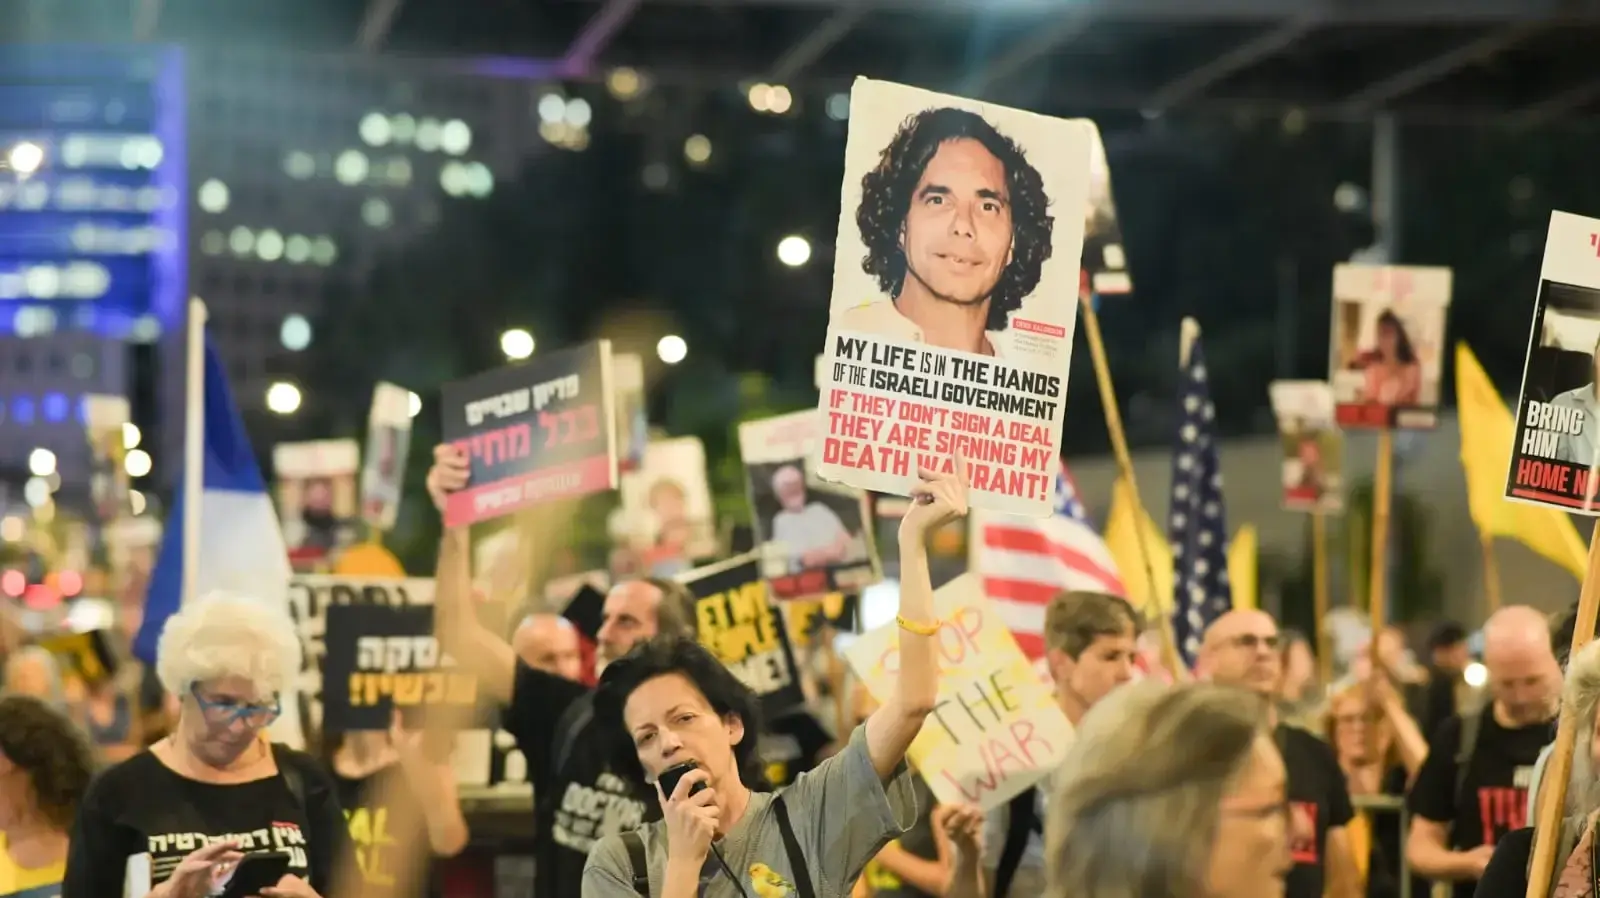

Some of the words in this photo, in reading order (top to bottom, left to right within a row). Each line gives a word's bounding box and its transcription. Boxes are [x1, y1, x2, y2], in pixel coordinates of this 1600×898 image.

[833, 362, 847, 382] OF
[848, 365, 868, 388] THE
[869, 369, 939, 400] ISRAELI
[942, 382, 1058, 421] GOVERNMENT
[835, 336, 868, 361] MY
[871, 343, 917, 371] LIFE
[920, 351, 933, 374] IS
[934, 354, 947, 377] IN
[951, 357, 989, 384] THE
[993, 365, 1061, 398] HANDS
[537, 404, 599, 451] בכל
[829, 389, 848, 409] IF
[850, 393, 897, 418] THEY
[898, 402, 949, 428] DON'T
[951, 411, 991, 436] SIGN
[992, 419, 1005, 439] A
[1009, 422, 1053, 447] DEAL
[829, 412, 884, 441] THEY
[887, 423, 932, 450] ARE
[936, 431, 1018, 466] SIGNING
[1020, 447, 1052, 472] MY
[1521, 428, 1560, 460] HIM
[1526, 400, 1585, 436] BRING
[823, 438, 910, 476] DEATH
[917, 454, 1049, 501] WARANT!
[1516, 458, 1570, 493] HOME
[930, 669, 1020, 746] THE
[941, 719, 1054, 803] WAR
